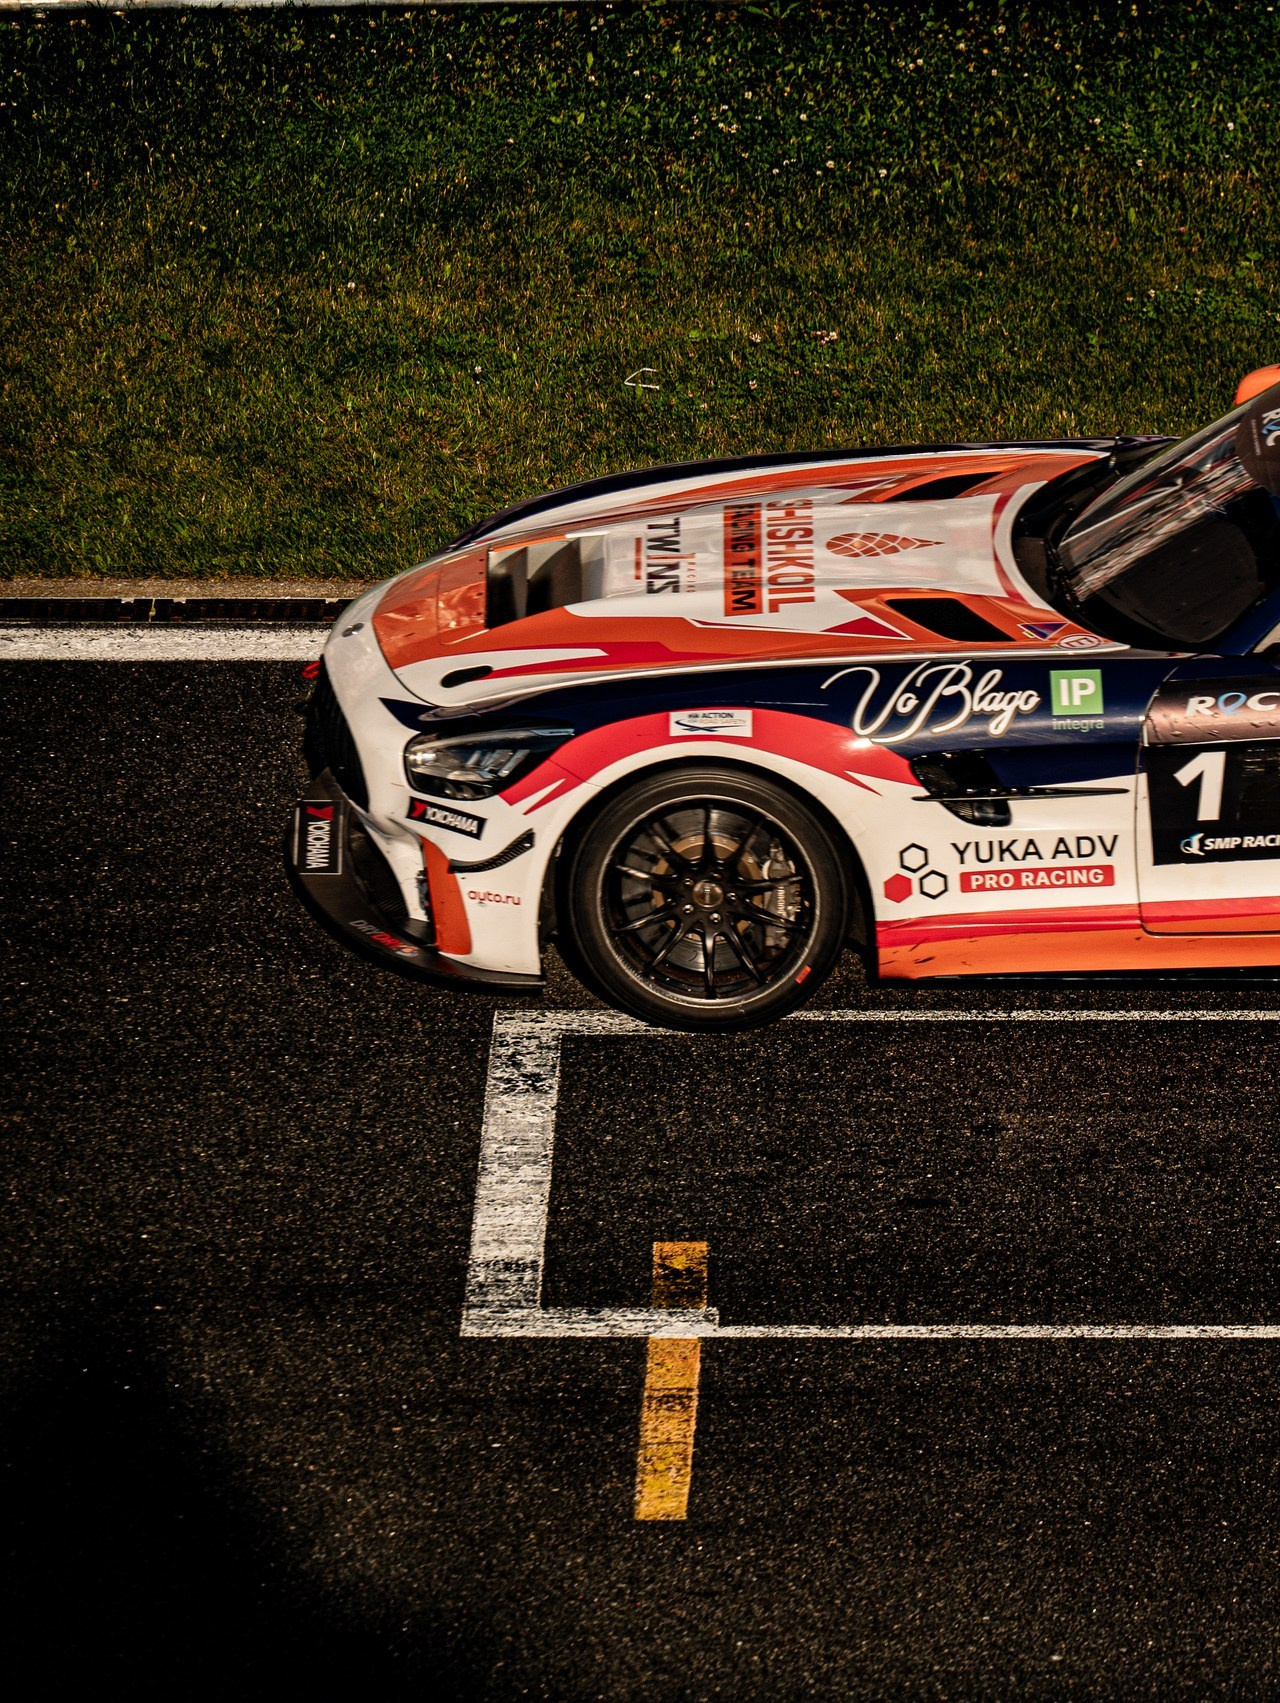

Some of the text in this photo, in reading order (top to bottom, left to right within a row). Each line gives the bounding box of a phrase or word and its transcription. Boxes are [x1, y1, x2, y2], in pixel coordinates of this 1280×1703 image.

[646, 516, 695, 595] TWINS
[767, 498, 816, 613] SHISHKOIL
[731, 558, 756, 611] TEAM
[1060, 678, 1096, 707] IP
[1052, 717, 1106, 733] integra
[1173, 751, 1227, 822] 1
[425, 806, 479, 834] YOKOHAMA
[306, 820, 330, 869] YOKOHAMA
[951, 834, 1119, 865] YUKA ADV
[1203, 835, 1242, 851] SMP
[970, 869, 1105, 889] PRO RACING
[468, 890, 521, 906] auto.ru
